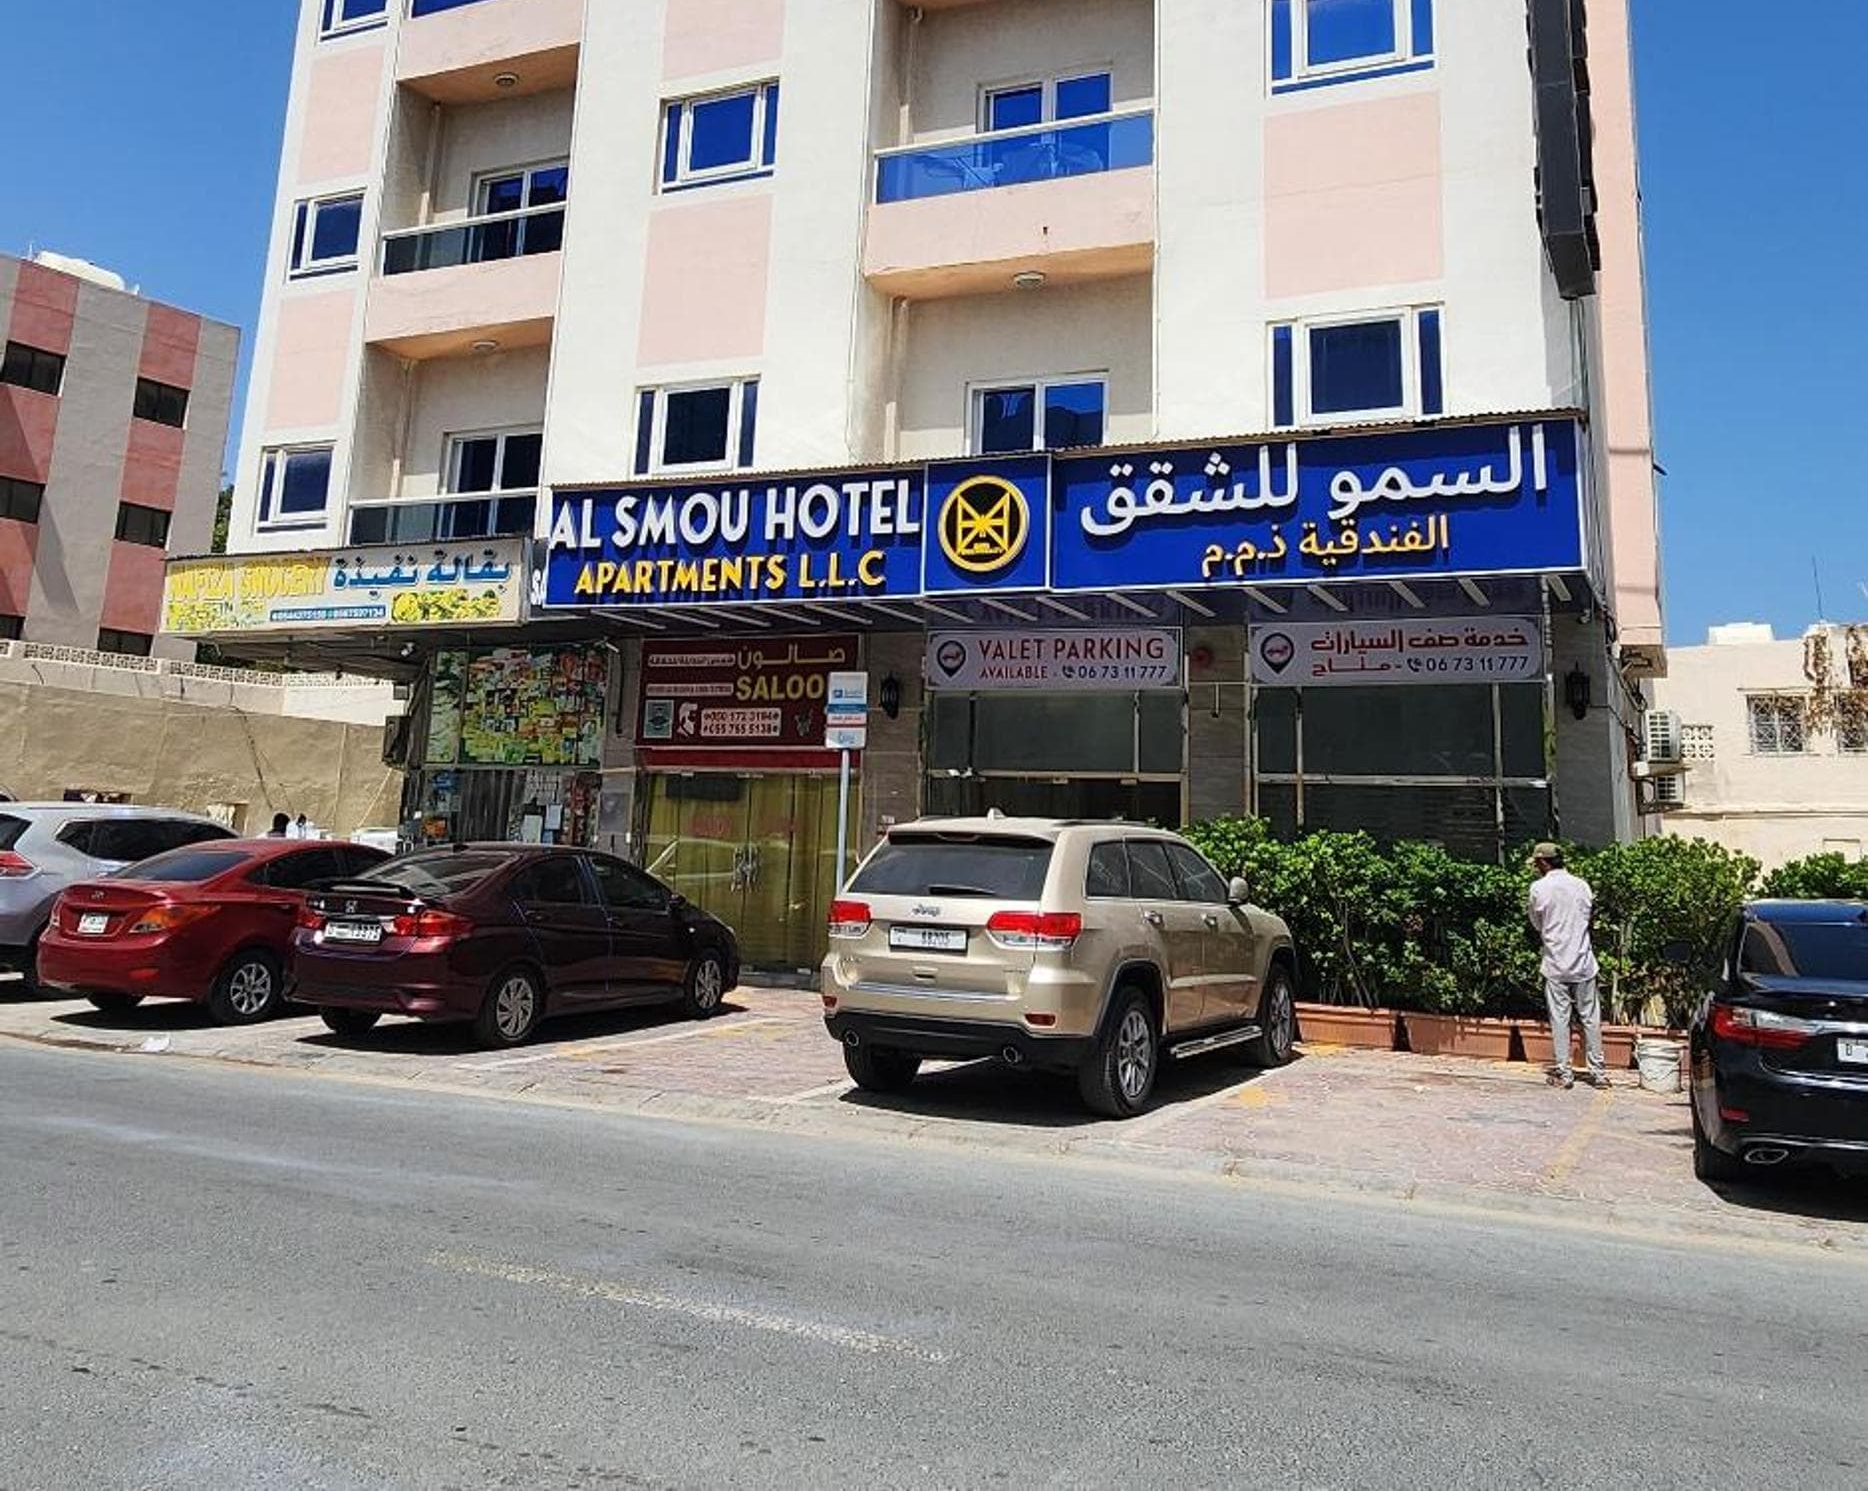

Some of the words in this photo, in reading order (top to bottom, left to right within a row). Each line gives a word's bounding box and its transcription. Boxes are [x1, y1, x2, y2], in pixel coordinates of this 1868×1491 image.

[1327, 423, 1547, 520] السمو
[1080, 442, 1299, 536] للشقق
[549, 498, 602, 550] AL
[611, 489, 749, 548] SMOU
[764, 479, 920, 541] HOTEL
[1299, 513, 1449, 566] الفندقية
[426, 547, 513, 595] بقالة
[574, 554, 787, 594] APARTMENTS
[798, 549, 886, 588] L.L.C
[978, 638, 1047, 661] VALET
[1053, 637, 1165, 660] PARKING
[1310, 629, 1404, 655] السيارات
[1408, 628, 1459, 649] صف
[1463, 626, 1529, 648] خدمة
[737, 642, 846, 671] صالون
[1311, 656, 1392, 677] متاح
[1426, 657, 1448, 672] 06
[1453, 656, 1474, 671] 73
[1478, 656, 1494, 671] 11
[1497, 655, 1529, 671] 777
[979, 665, 1048, 680] AVAILABLE
[1077, 665, 1097, 679] 06
[1101, 665, 1120, 679] 73
[1124, 665, 1136, 679] 11
[1139, 664, 1168, 679] 777
[735, 673, 825, 702] SALOO
